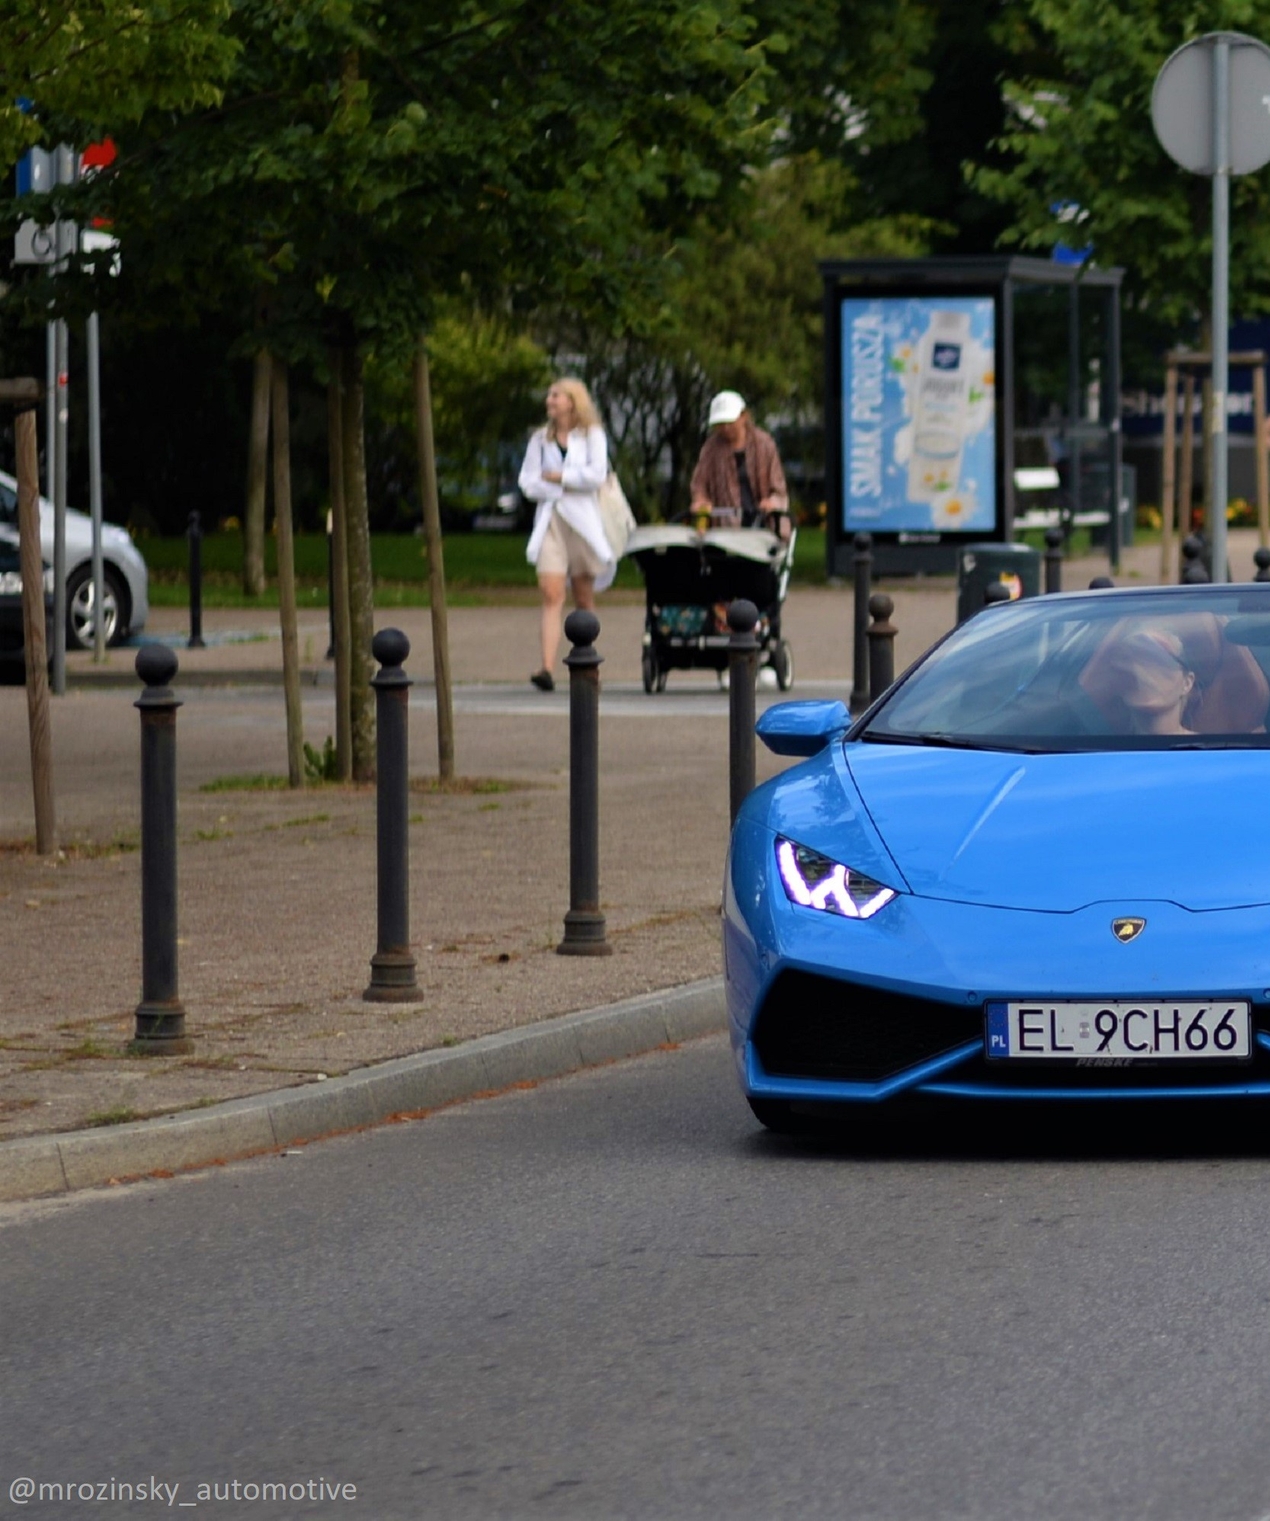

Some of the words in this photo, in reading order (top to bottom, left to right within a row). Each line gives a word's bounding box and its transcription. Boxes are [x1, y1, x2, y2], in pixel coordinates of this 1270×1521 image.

[850, 428, 882, 498] SMAK
[991, 1034, 1007, 1048] PL
[1017, 1008, 1075, 1053] EL
[1094, 1008, 1238, 1053] 9CH66
